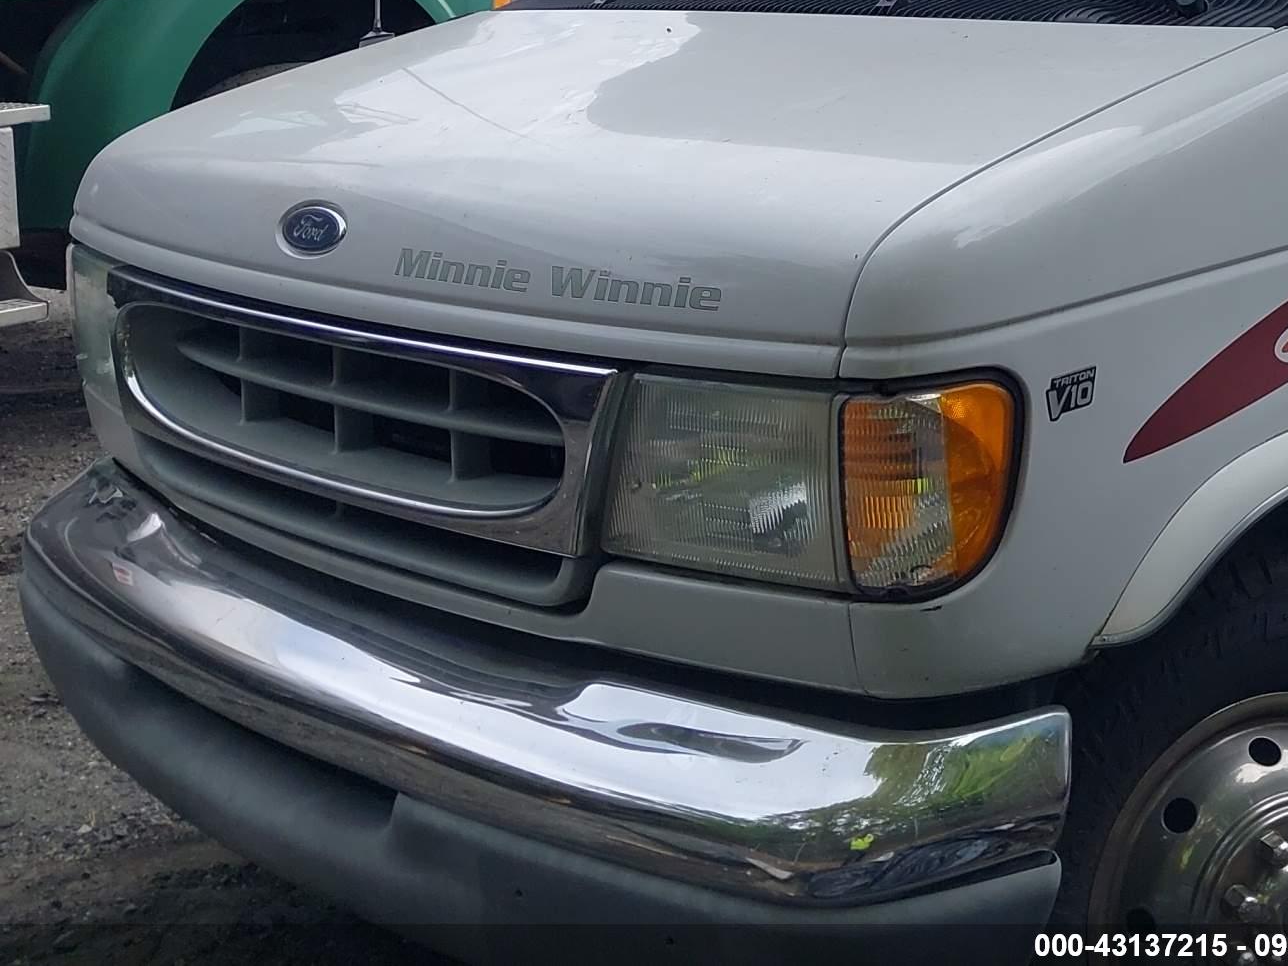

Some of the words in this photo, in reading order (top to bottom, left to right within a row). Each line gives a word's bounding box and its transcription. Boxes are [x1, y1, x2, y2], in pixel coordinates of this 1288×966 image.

[293, 214, 329, 241] Ford
[394, 247, 531, 293] Minnie
[551, 265, 722, 312] Winnie
[1053, 368, 1096, 388] TRITON
[1048, 380, 1093, 420] V10
